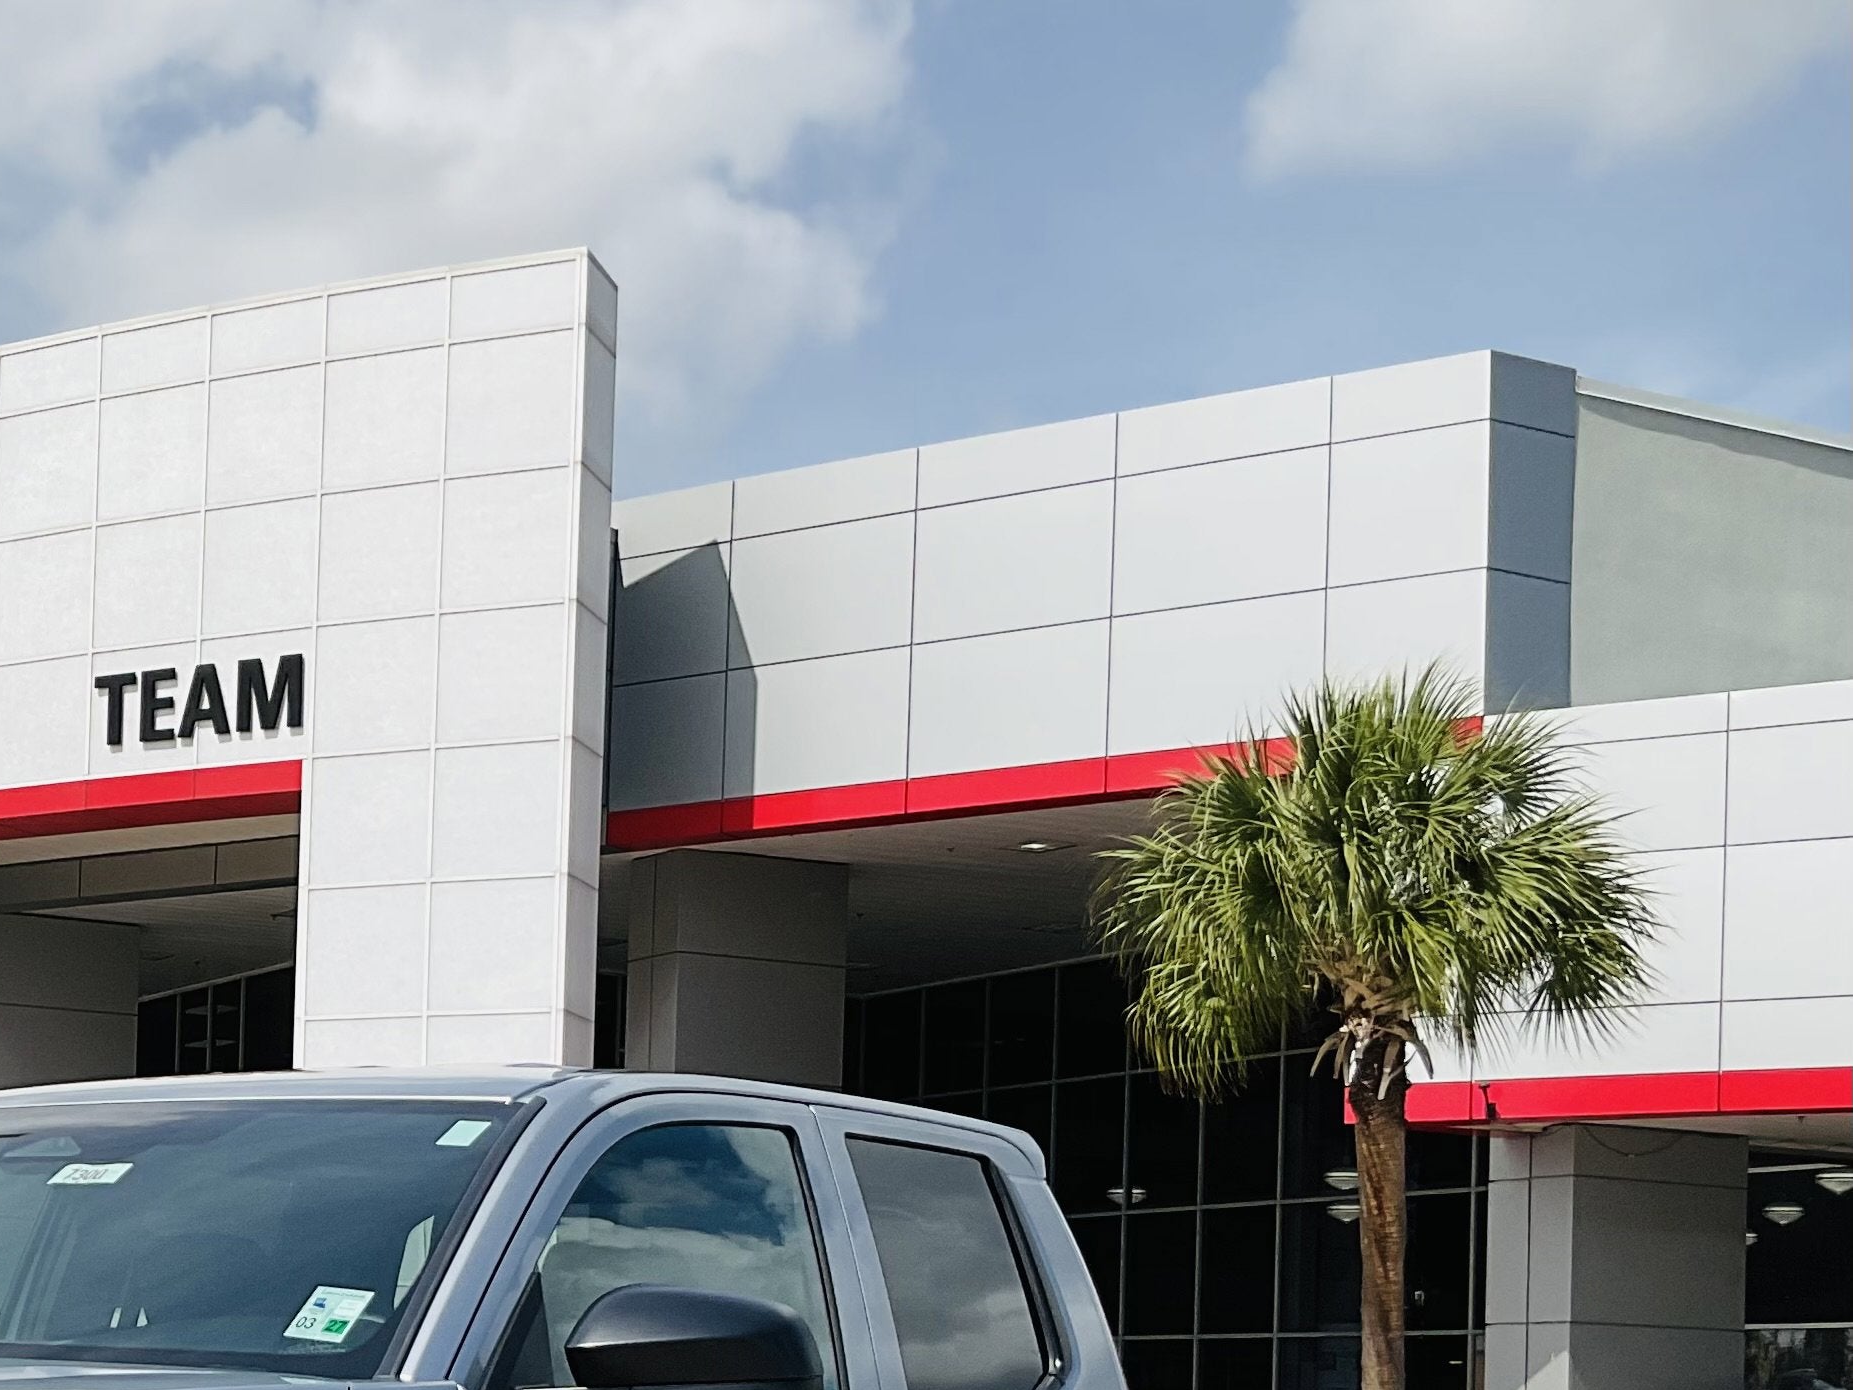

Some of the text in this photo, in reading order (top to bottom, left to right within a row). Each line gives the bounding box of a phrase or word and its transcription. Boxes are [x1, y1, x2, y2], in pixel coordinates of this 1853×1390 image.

[94, 653, 305, 746] TEAM
[295, 1316, 349, 1333] 03 27
